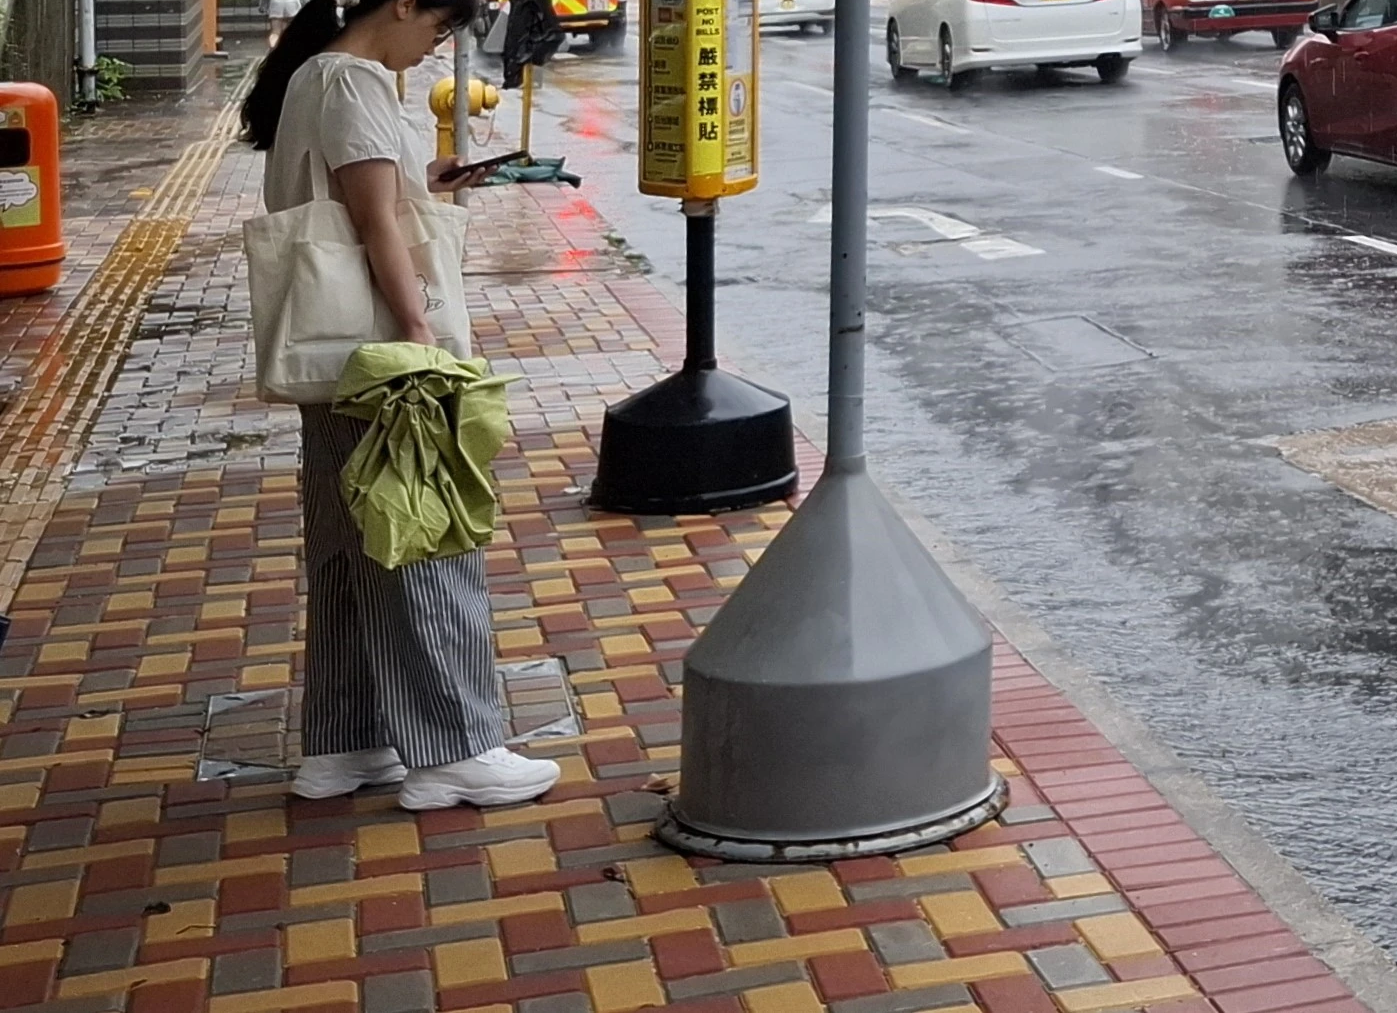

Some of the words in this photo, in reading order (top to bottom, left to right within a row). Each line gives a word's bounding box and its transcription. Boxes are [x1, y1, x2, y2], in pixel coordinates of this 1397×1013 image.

[696, 8, 719, 16] POST
[696, 28, 720, 36] BILLS
[698, 47, 718, 141] 嚴禁標貼
